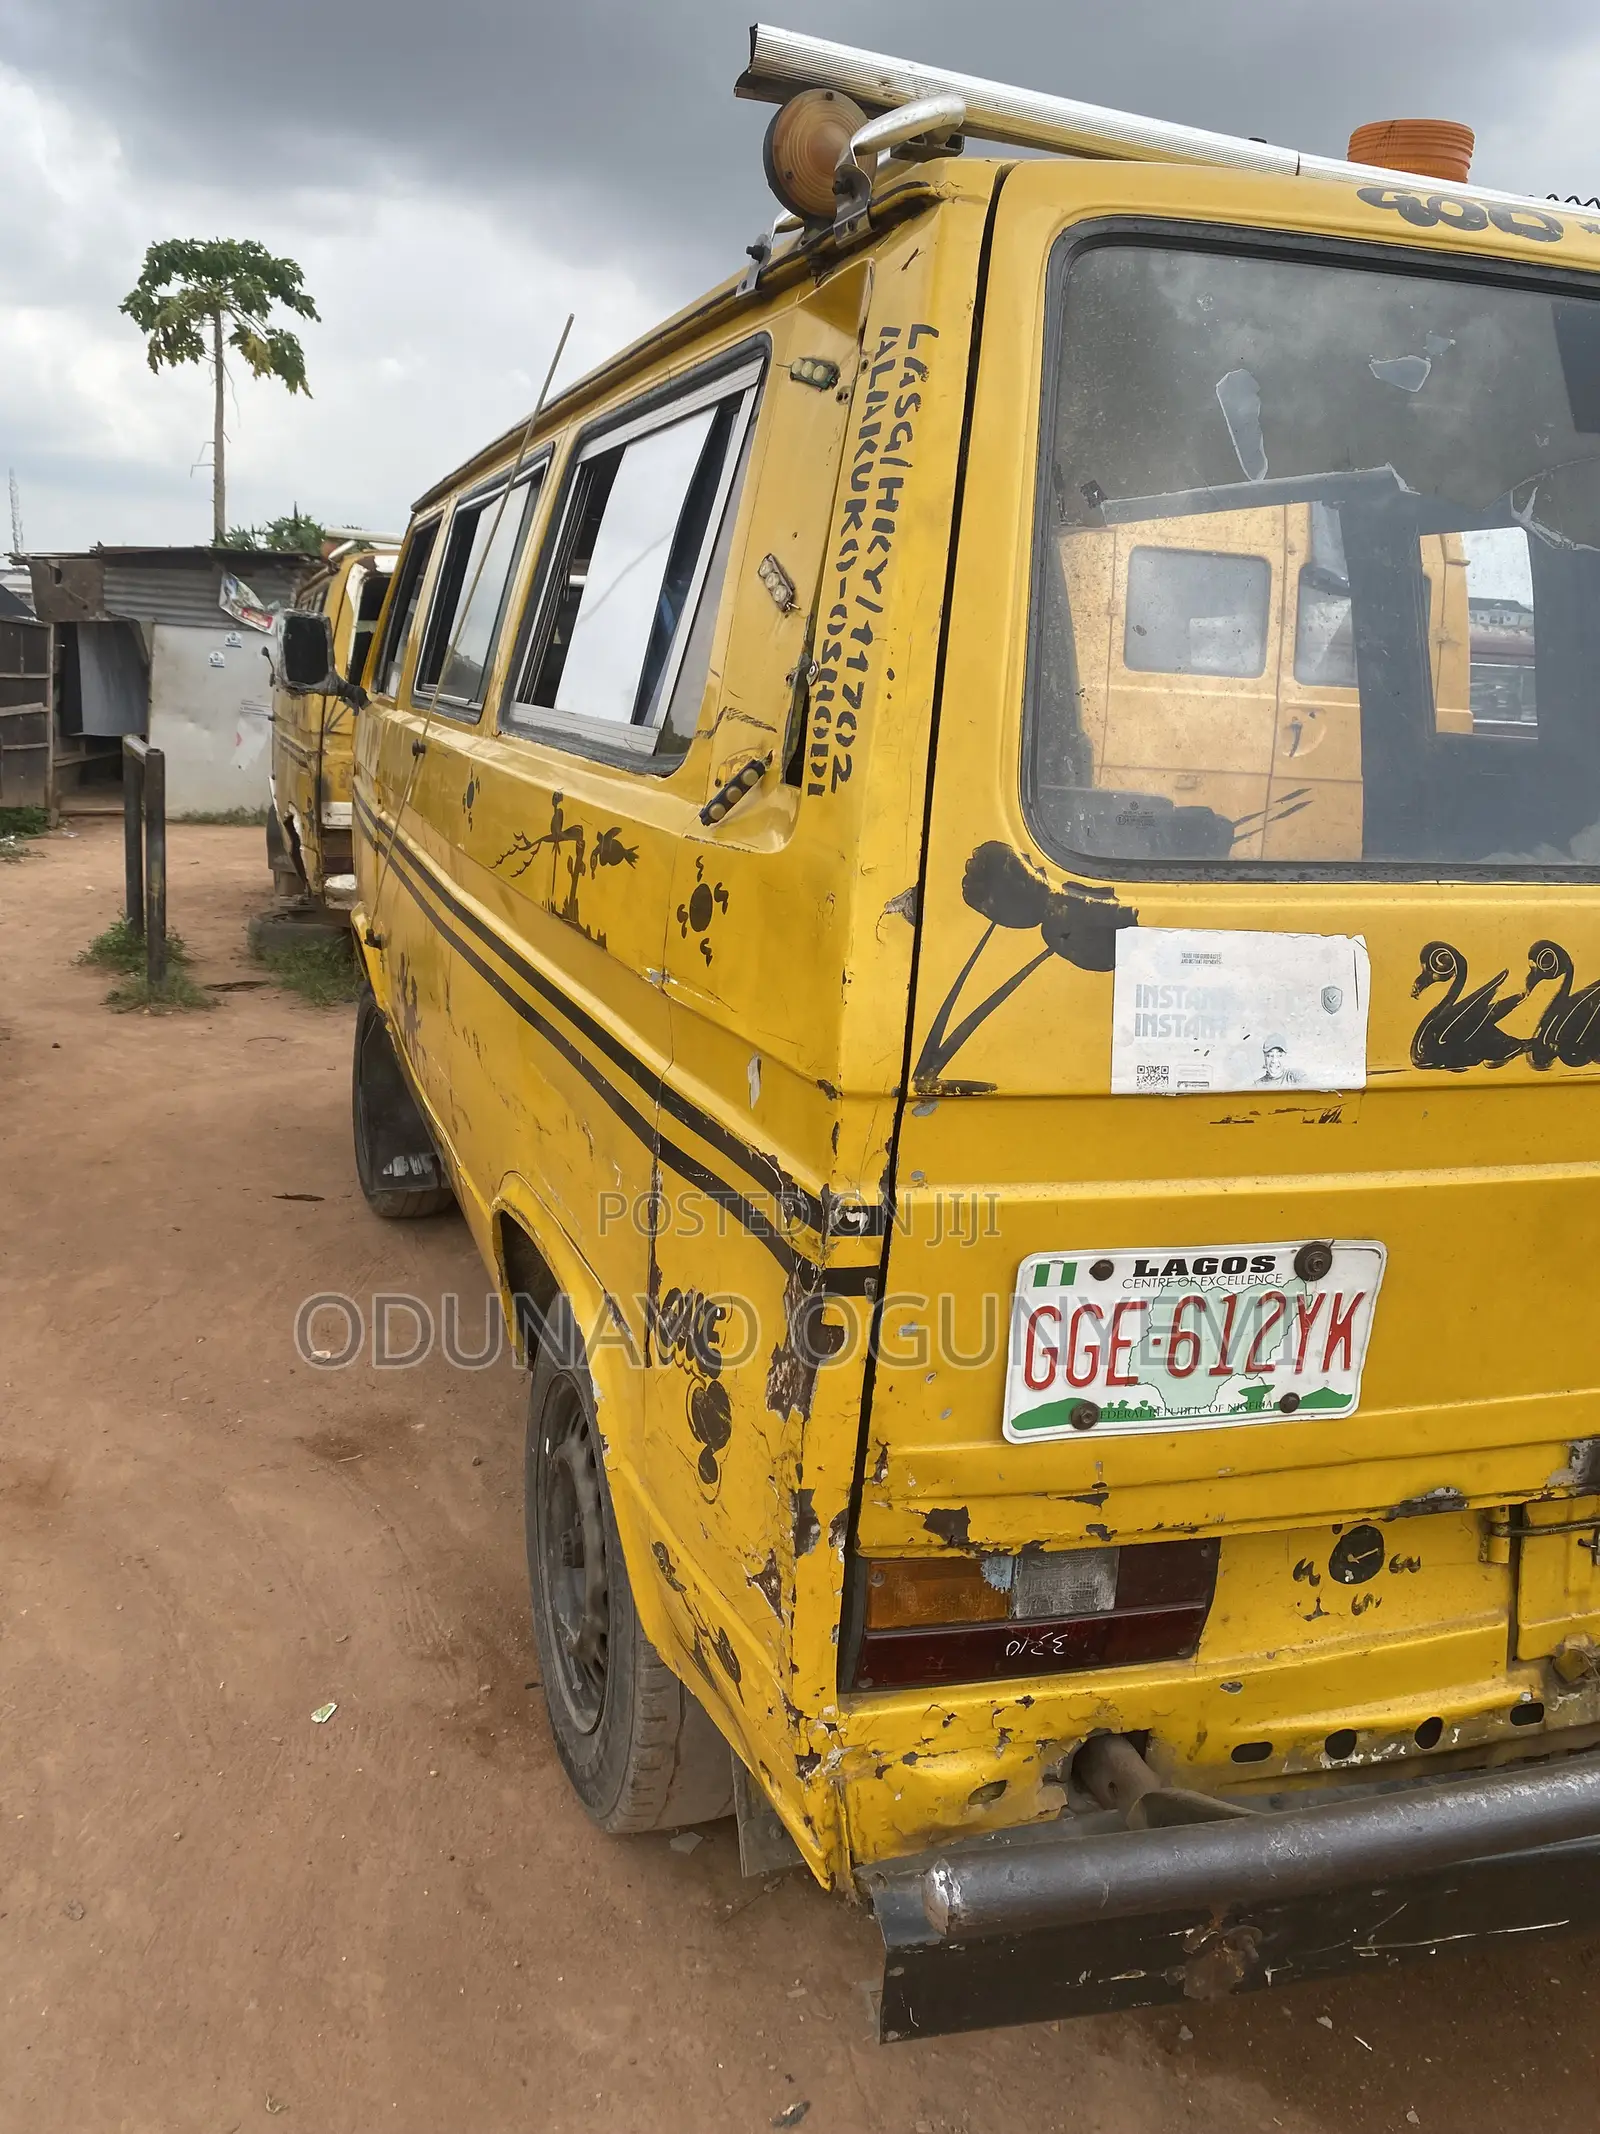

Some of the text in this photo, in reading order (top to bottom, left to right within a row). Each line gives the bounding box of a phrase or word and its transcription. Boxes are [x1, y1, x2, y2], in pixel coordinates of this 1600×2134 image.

[807, 326, 902, 797] ALAKUKO-OSHODI
[831, 323, 939, 793] LASG/HKY/11702
[1132, 1255, 1277, 1277] LAGOS
[1122, 1273, 1283, 1289] CENTRE OF EXCELLENCE
[1099, 1408, 1145, 1419] EDERAL
